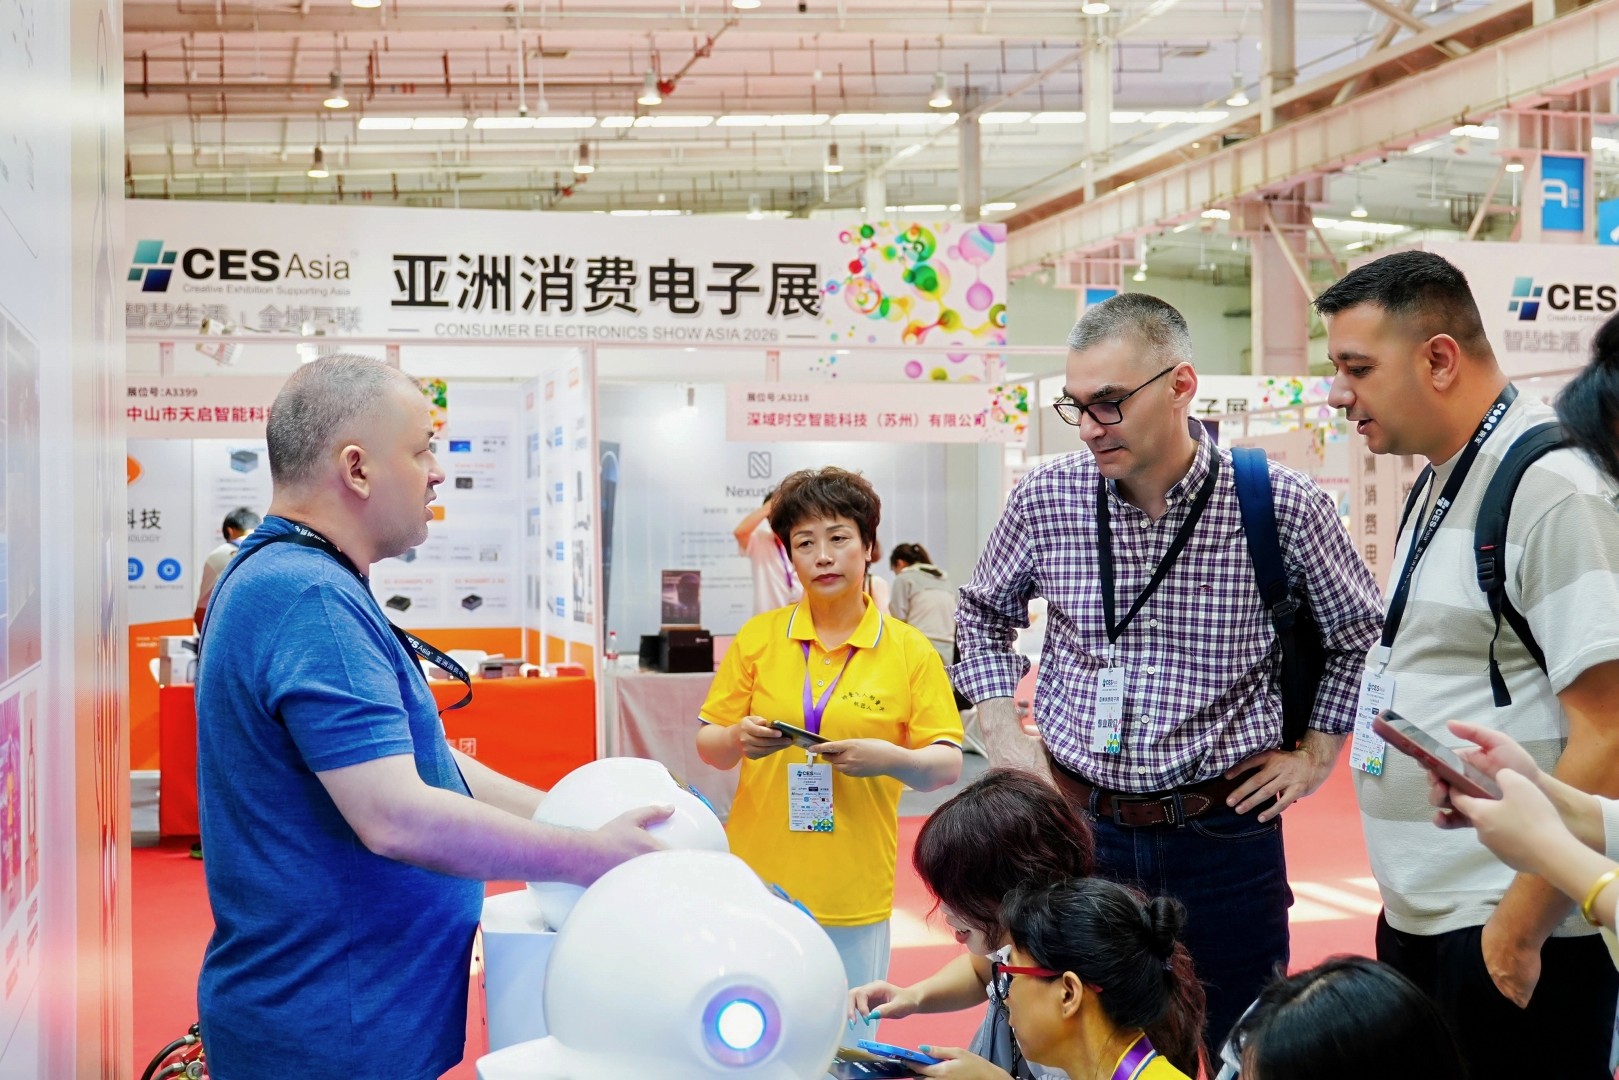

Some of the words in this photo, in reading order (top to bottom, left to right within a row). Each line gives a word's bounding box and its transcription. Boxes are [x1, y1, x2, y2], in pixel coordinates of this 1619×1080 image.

[182, 248, 280, 282] CES
[285, 253, 350, 280] Asia
[183, 283, 222, 294] Creative
[226, 284, 273, 295] Exhibition
[276, 285, 328, 297] Supporting
[330, 287, 350, 296] Asia
[391, 253, 821, 317] 亚洲消费电子展
[1547, 284, 1617, 313] CES
[434, 323, 530, 338] CONSUMER
[534, 324, 649, 340] ELECTRONICS
[652, 326, 701, 341] SHOW
[705, 327, 740, 341] ASIA
[743, 328, 778, 342] 2026
[126, 406, 272, 424] 中山市天启智能科
[1429, 509, 1443, 528] CES
[406, 635, 420, 649] ES
[417, 645, 431, 657] Asia
